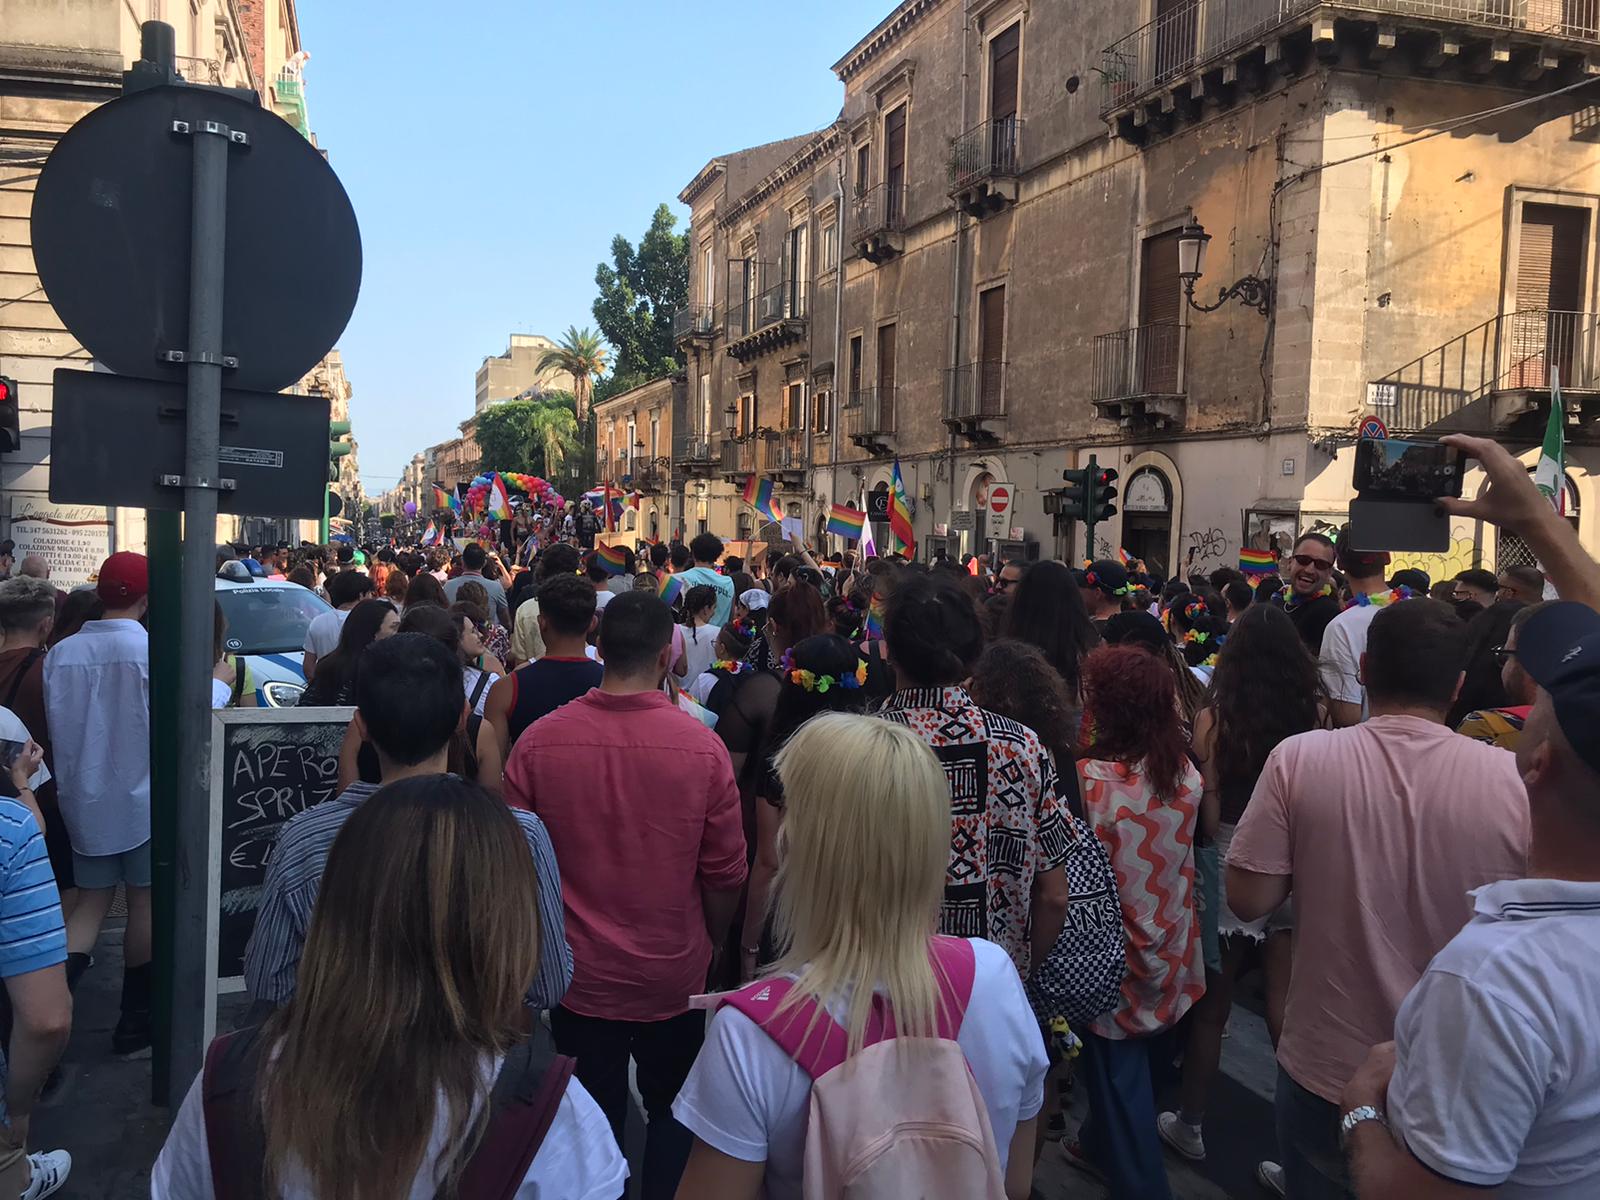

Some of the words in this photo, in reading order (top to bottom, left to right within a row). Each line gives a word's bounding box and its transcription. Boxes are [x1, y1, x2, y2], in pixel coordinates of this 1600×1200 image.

[33, 537, 69, 546] COLAZIONE
[19, 543, 55, 552] COLAZIONE
[57, 545, 83, 553] MIGNON
[53, 559, 75, 567] CALDA
[1059, 896, 1117, 937] ANS
